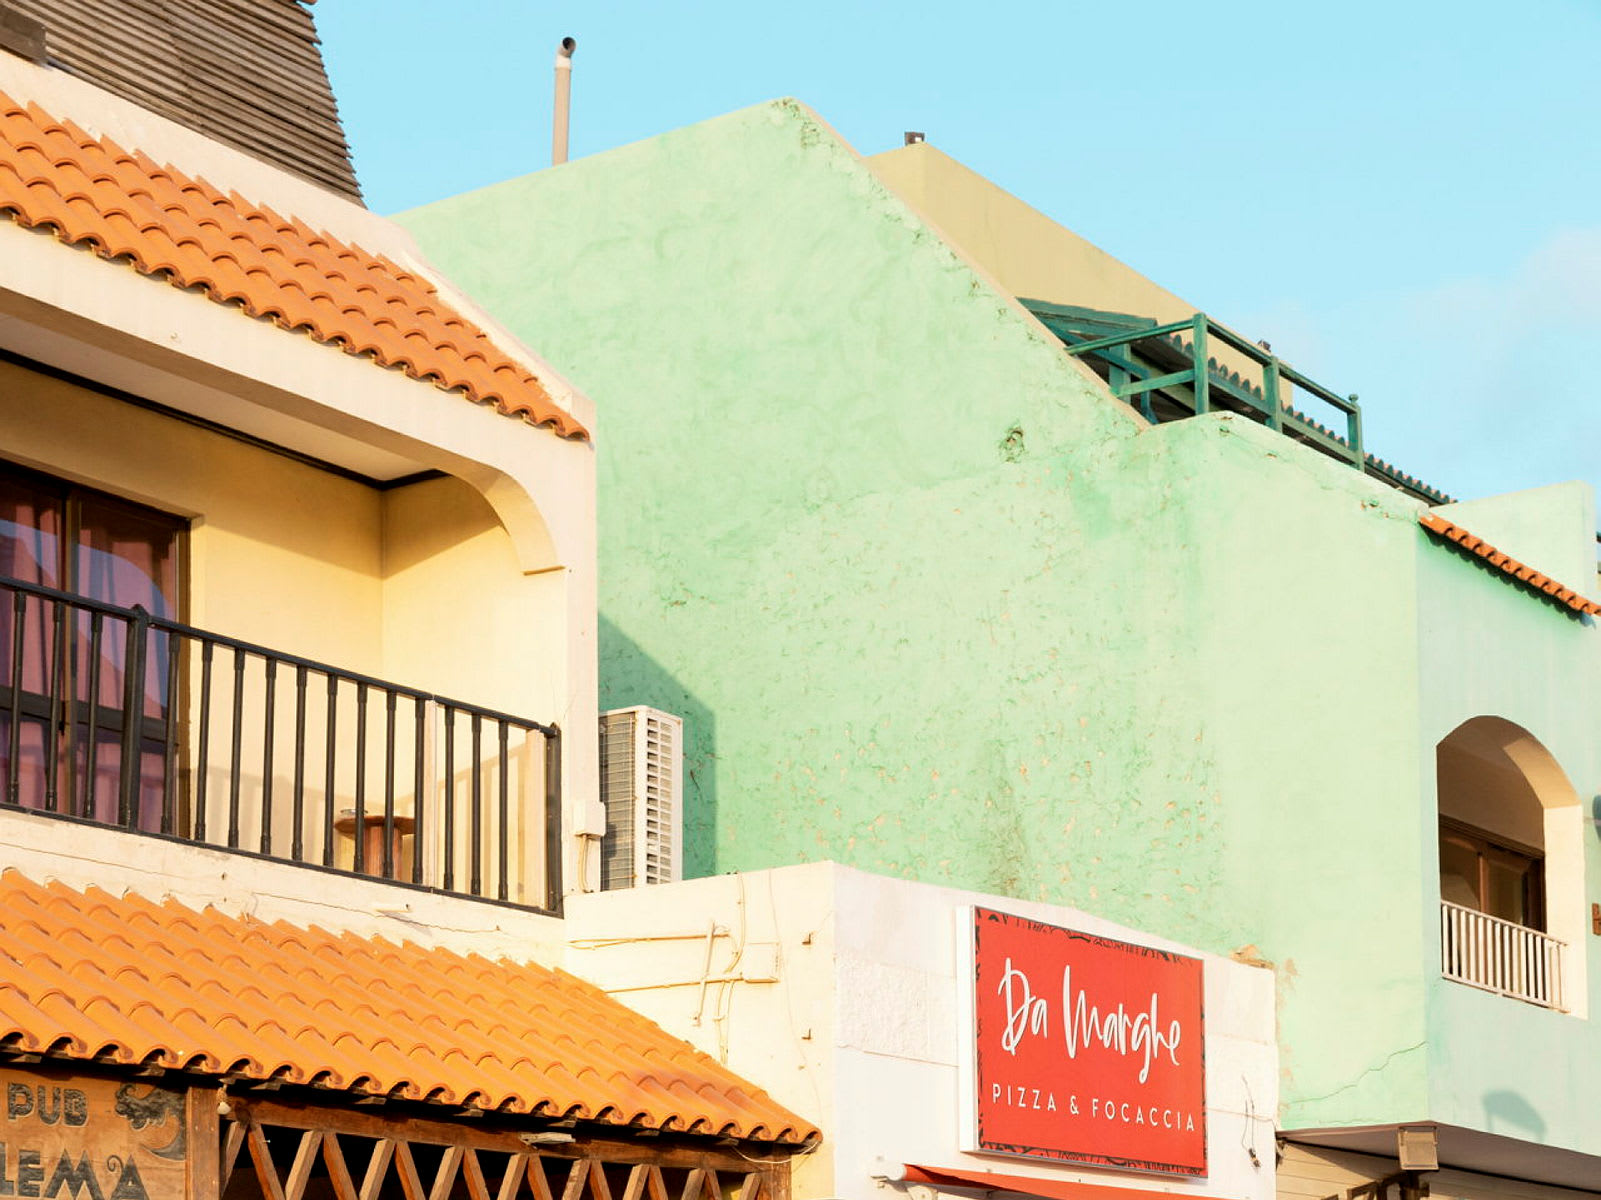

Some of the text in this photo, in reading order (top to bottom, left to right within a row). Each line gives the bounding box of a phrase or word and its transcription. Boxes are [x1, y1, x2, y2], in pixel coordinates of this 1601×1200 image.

[997, 957, 1181, 1084] Da Marghe
[7, 1082, 88, 1126] PUB
[992, 1083, 1195, 1132] PIZZA & FOCACCIA
